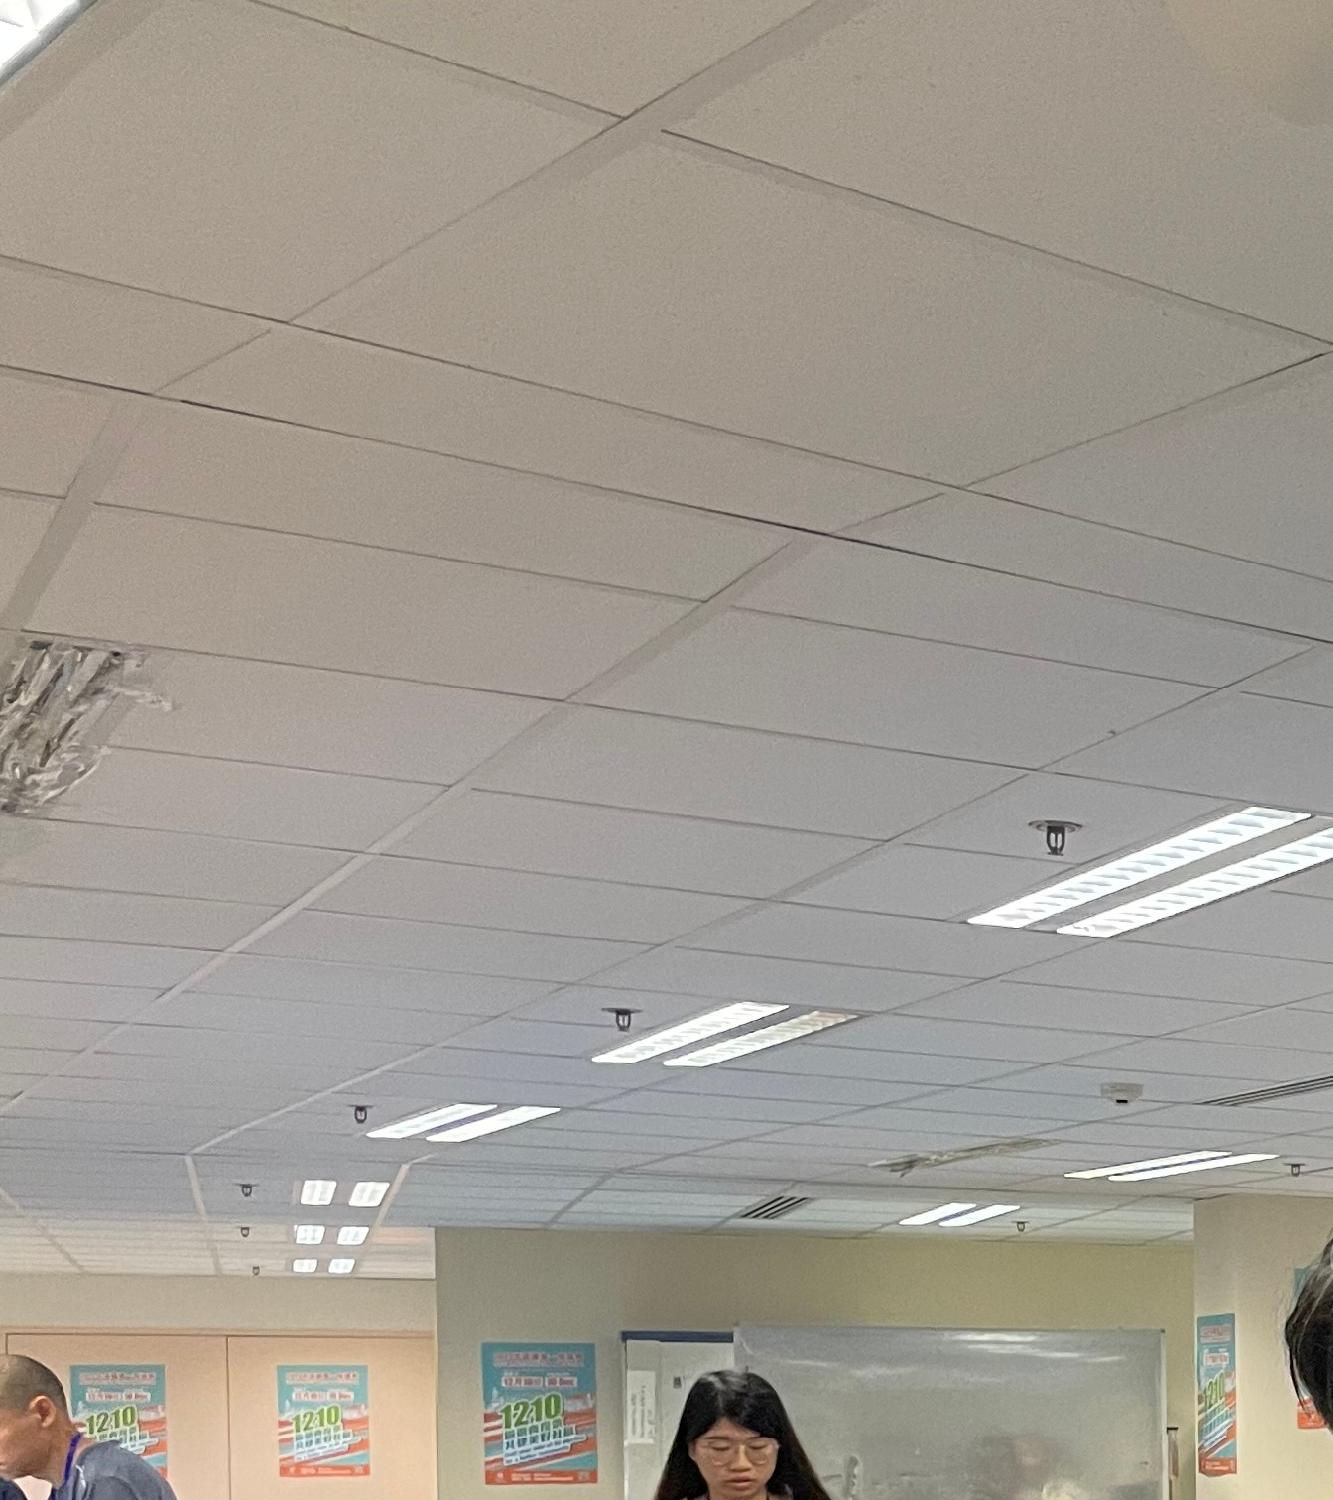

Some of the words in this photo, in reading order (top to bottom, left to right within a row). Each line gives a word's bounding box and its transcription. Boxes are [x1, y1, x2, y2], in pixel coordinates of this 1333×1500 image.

[86, 1406, 136, 1435] 1210
[292, 1405, 340, 1433] 1210
[501, 1393, 561, 1429] 1210
